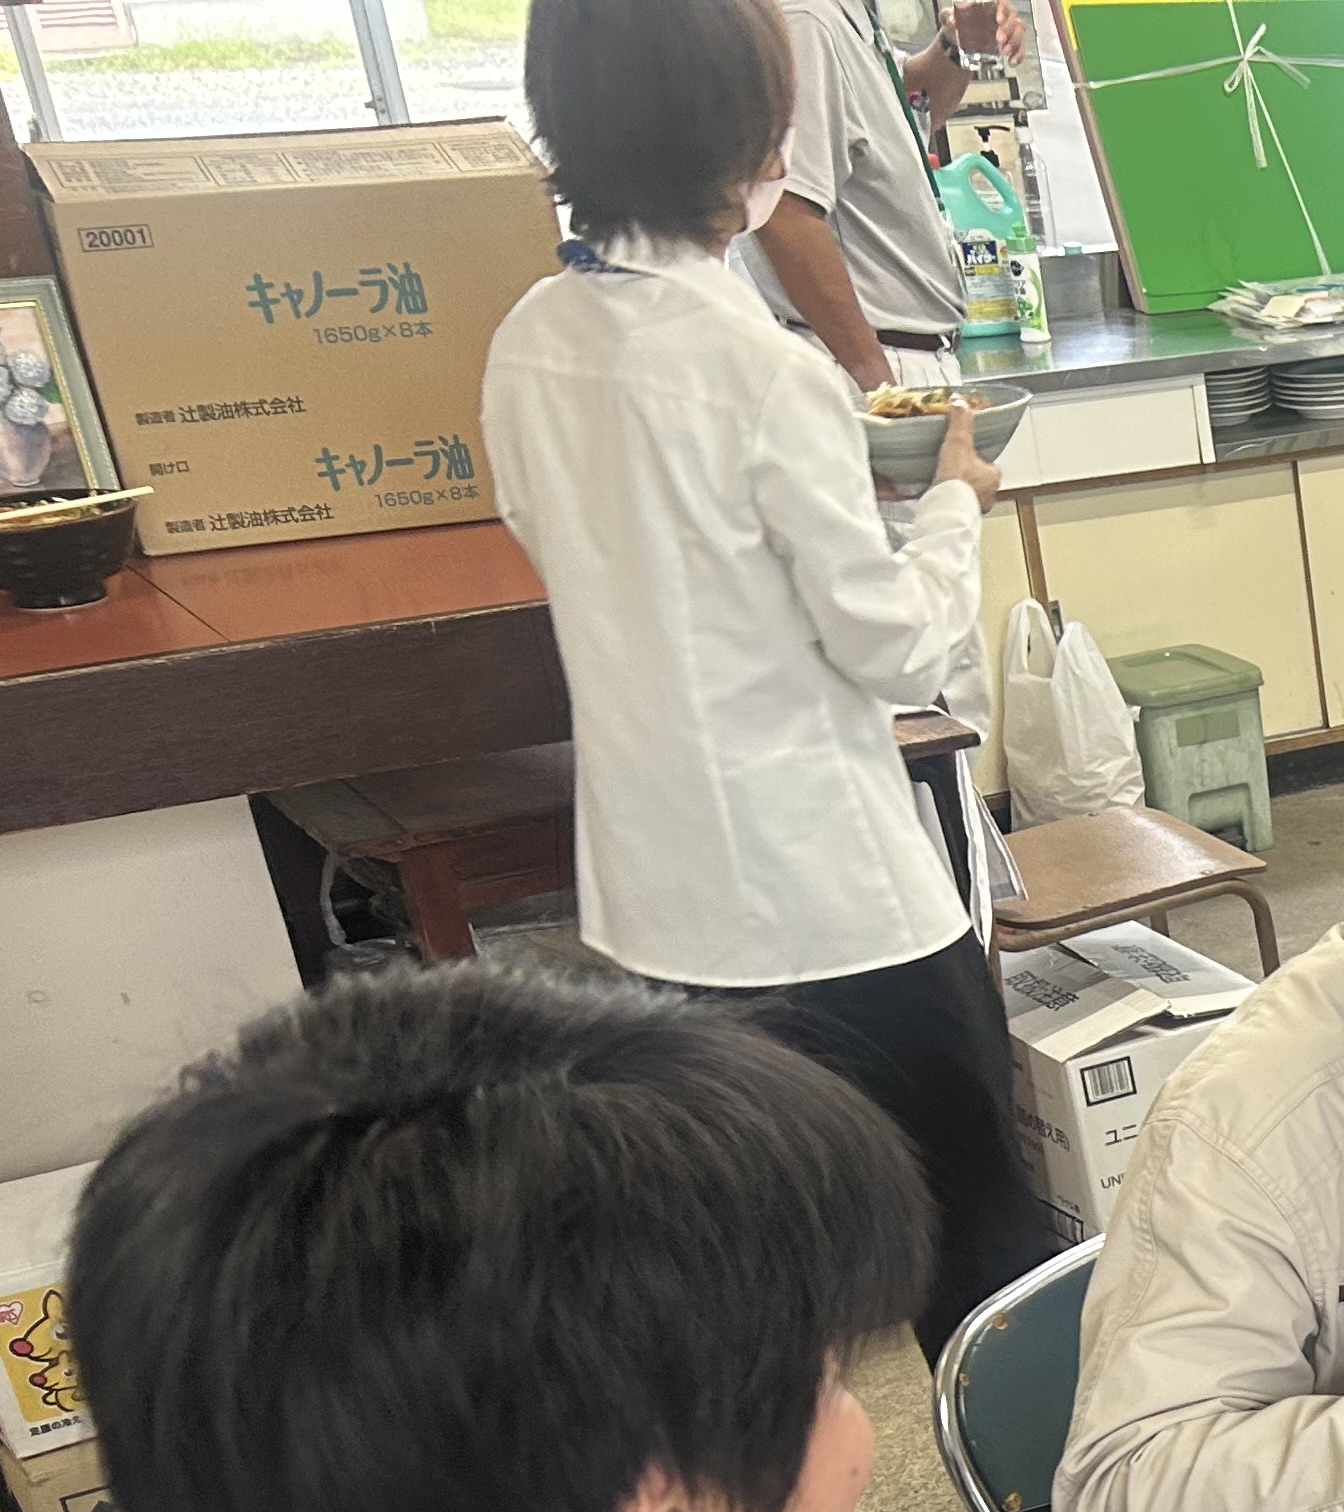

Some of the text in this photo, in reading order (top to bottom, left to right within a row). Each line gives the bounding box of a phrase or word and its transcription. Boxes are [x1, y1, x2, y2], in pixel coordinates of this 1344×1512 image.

[86, 228, 147, 248] 20001
[246, 262, 429, 324] キャノーラ油
[314, 320, 432, 345] 1650g×8本
[179, 396, 306, 425] 辻製油株式会社
[149, 460, 190, 476] 開け口
[315, 434, 476, 492] キャノーラ油
[375, 484, 480, 508] 1650g×8本
[209, 503, 335, 532] 辻製油株式会社
